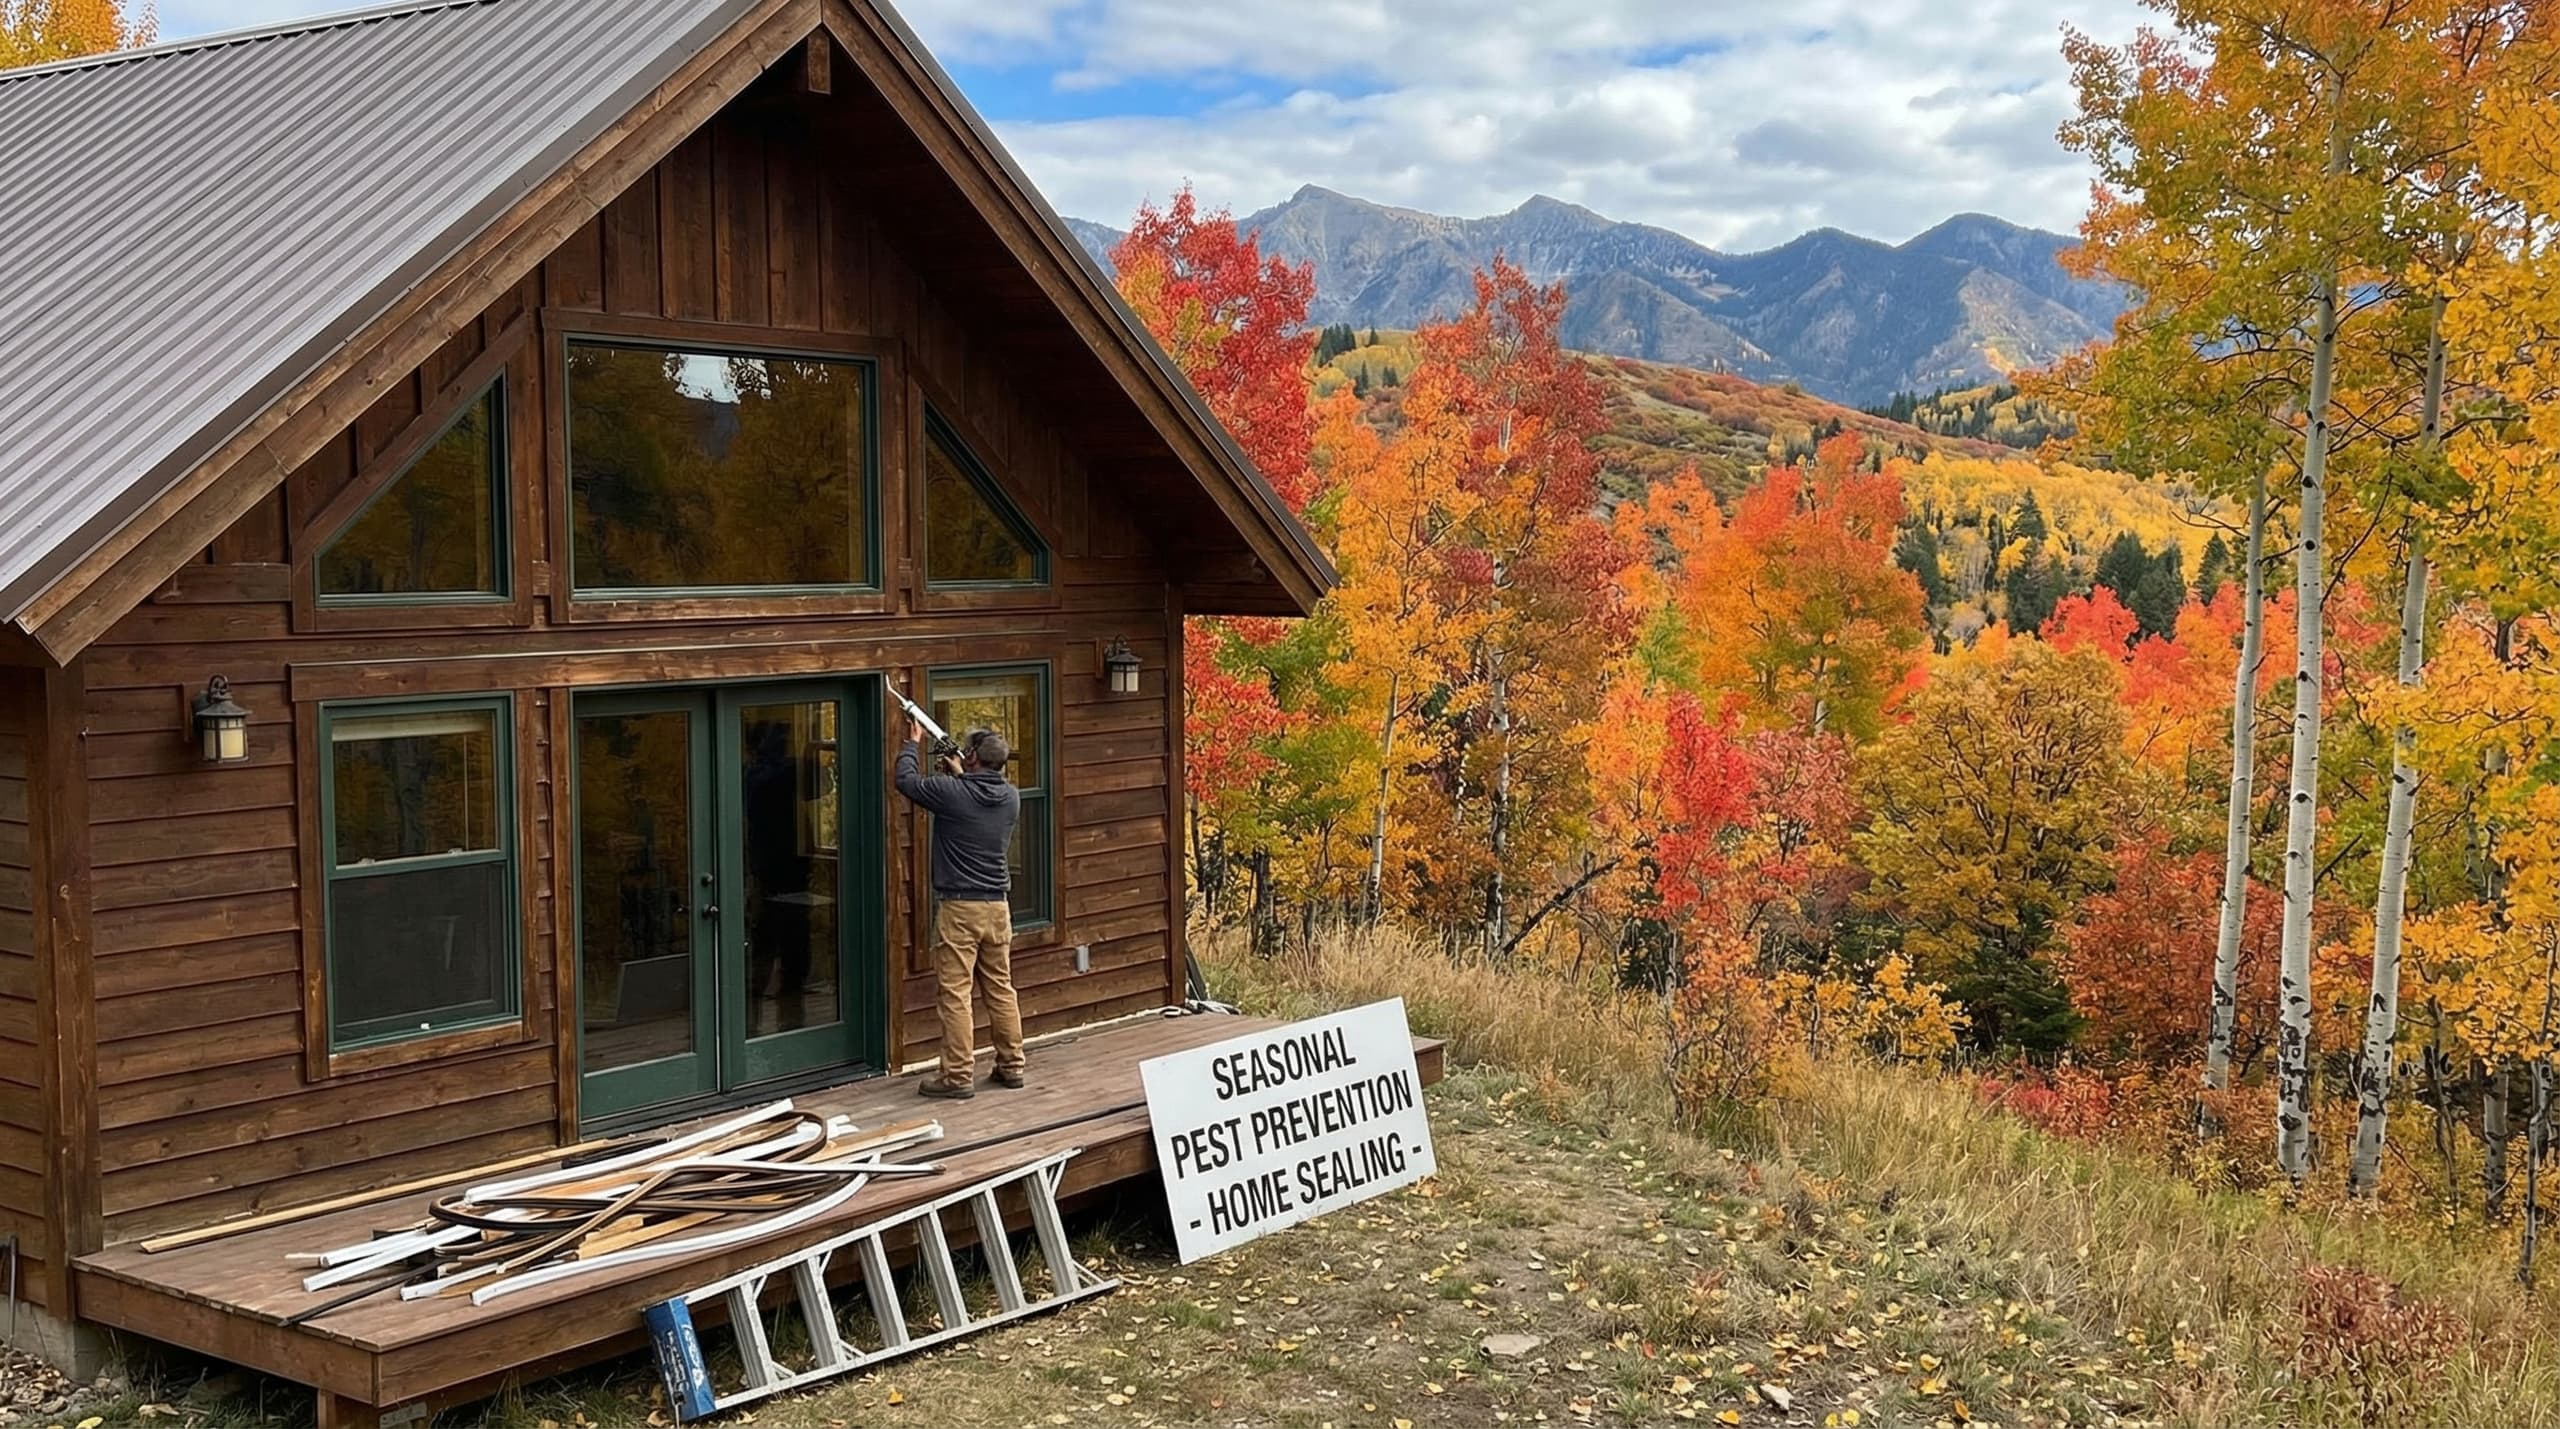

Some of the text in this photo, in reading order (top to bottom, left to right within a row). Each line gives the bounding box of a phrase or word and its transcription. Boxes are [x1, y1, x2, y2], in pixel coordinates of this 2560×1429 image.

[1212, 1027, 1357, 1101] SEASONAL
[1170, 1069, 1414, 1180] PEST PREVENTION
[1190, 1132, 1422, 1236] - HOME SEALING -
